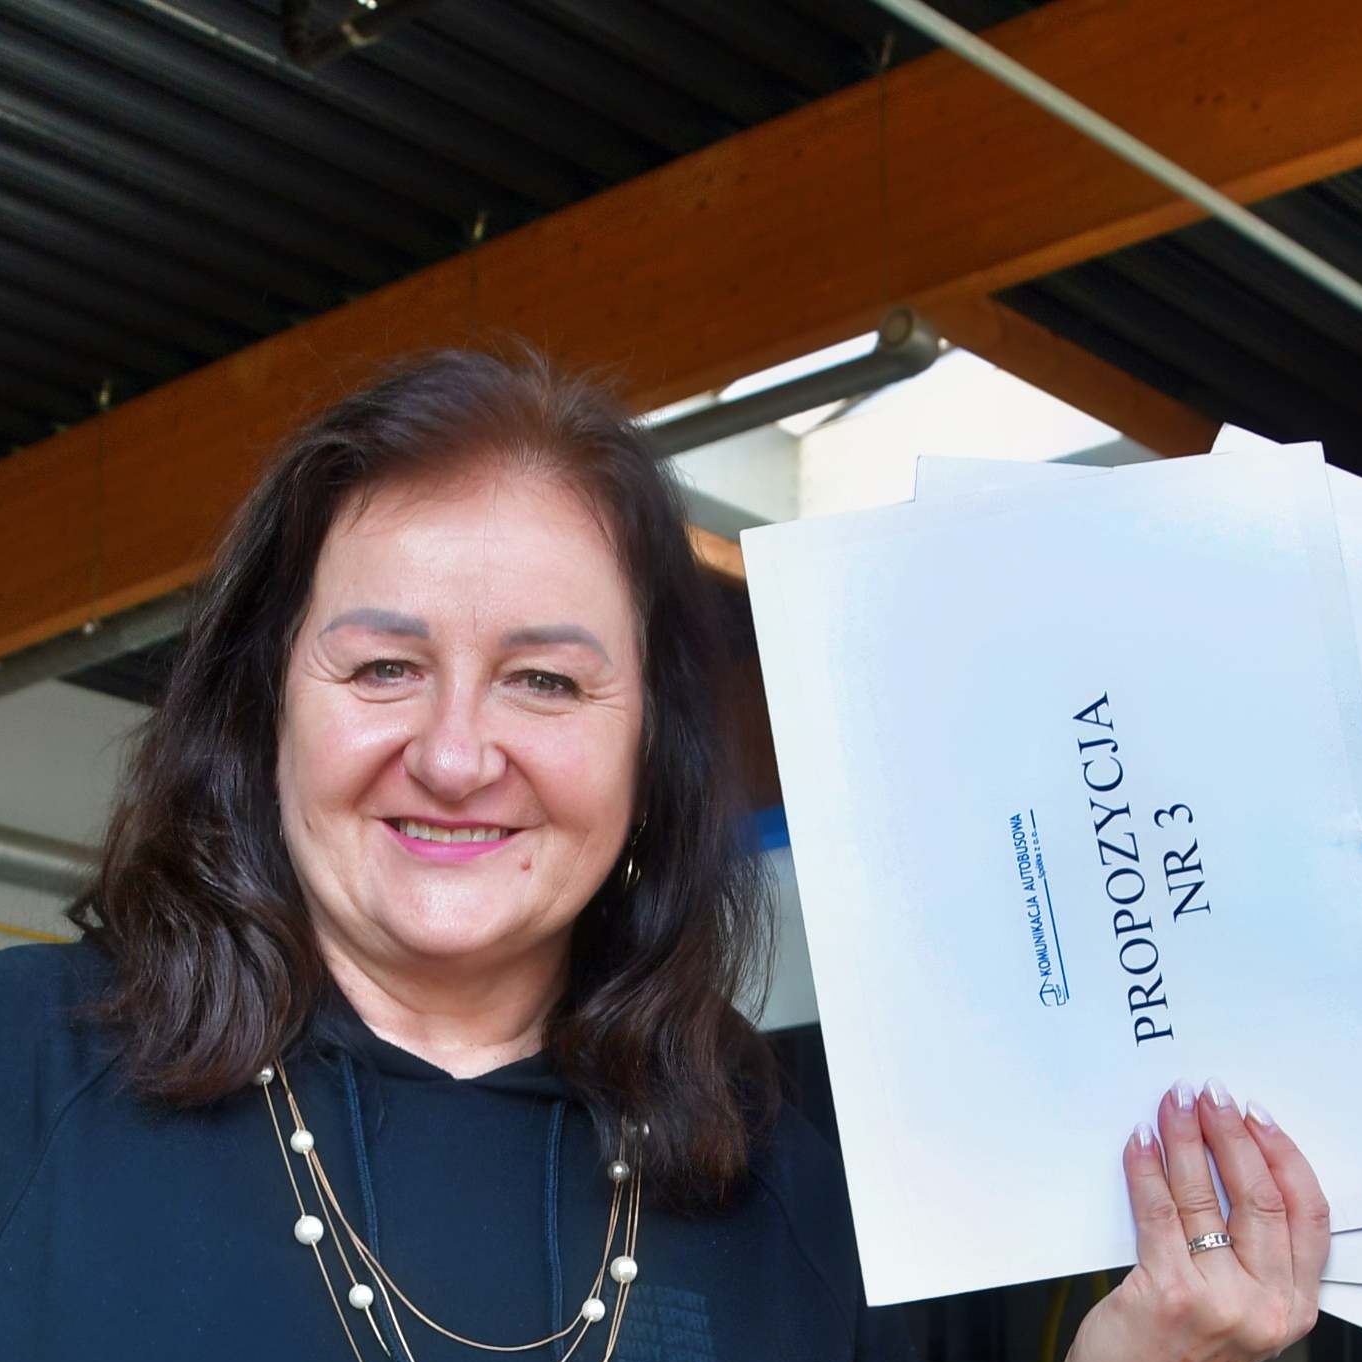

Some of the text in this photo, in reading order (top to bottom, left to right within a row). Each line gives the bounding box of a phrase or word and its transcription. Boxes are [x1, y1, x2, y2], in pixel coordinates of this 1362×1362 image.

[1009, 813, 1052, 977] KOMUNIKACJA AUTOBUSOWA
[1072, 691, 1175, 1048] PROPOZYCJA
[1153, 803, 1212, 924] NR 3
